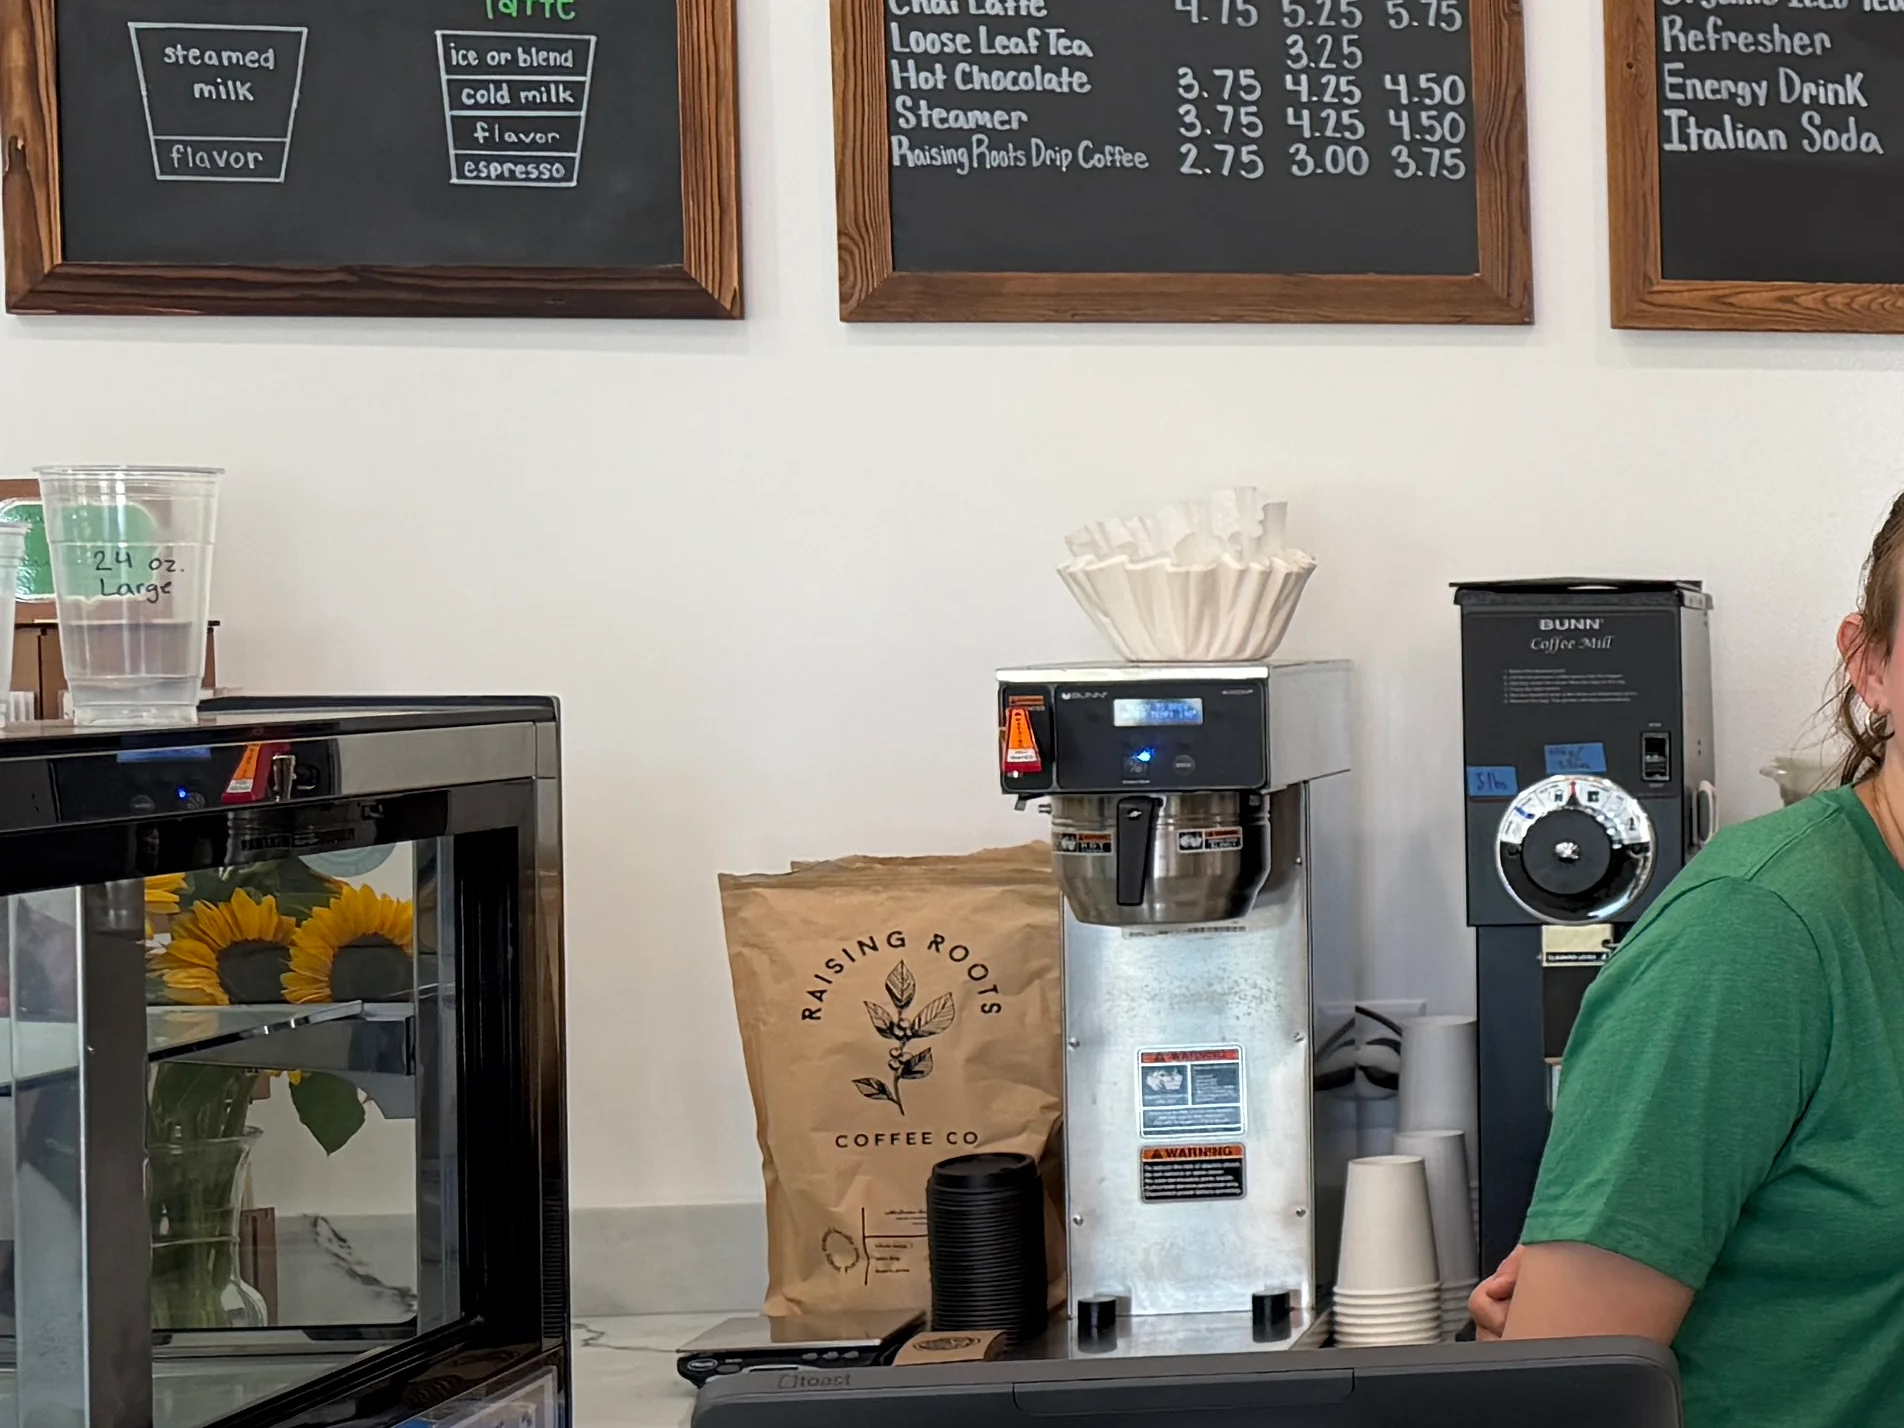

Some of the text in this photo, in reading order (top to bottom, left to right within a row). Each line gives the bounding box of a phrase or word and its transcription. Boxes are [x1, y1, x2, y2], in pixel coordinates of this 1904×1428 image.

[163, 43, 275, 70] steamed
[193, 77, 254, 101] milk
[461, 82, 575, 106] cold milk
[473, 121, 560, 144] flavor
[1662, 108, 1788, 152] Italian
[1800, 110, 1884, 155] Soda
[170, 144, 264, 169] flavor
[464, 160, 566, 180] espresso
[93, 550, 133, 571] 24
[100, 578, 173, 604] Large
[1530, 635, 1615, 654] Coffee Mill
[801, 929, 1002, 1022] RAISING ROOTS
[836, 1129, 980, 1149] COFFEE CO
